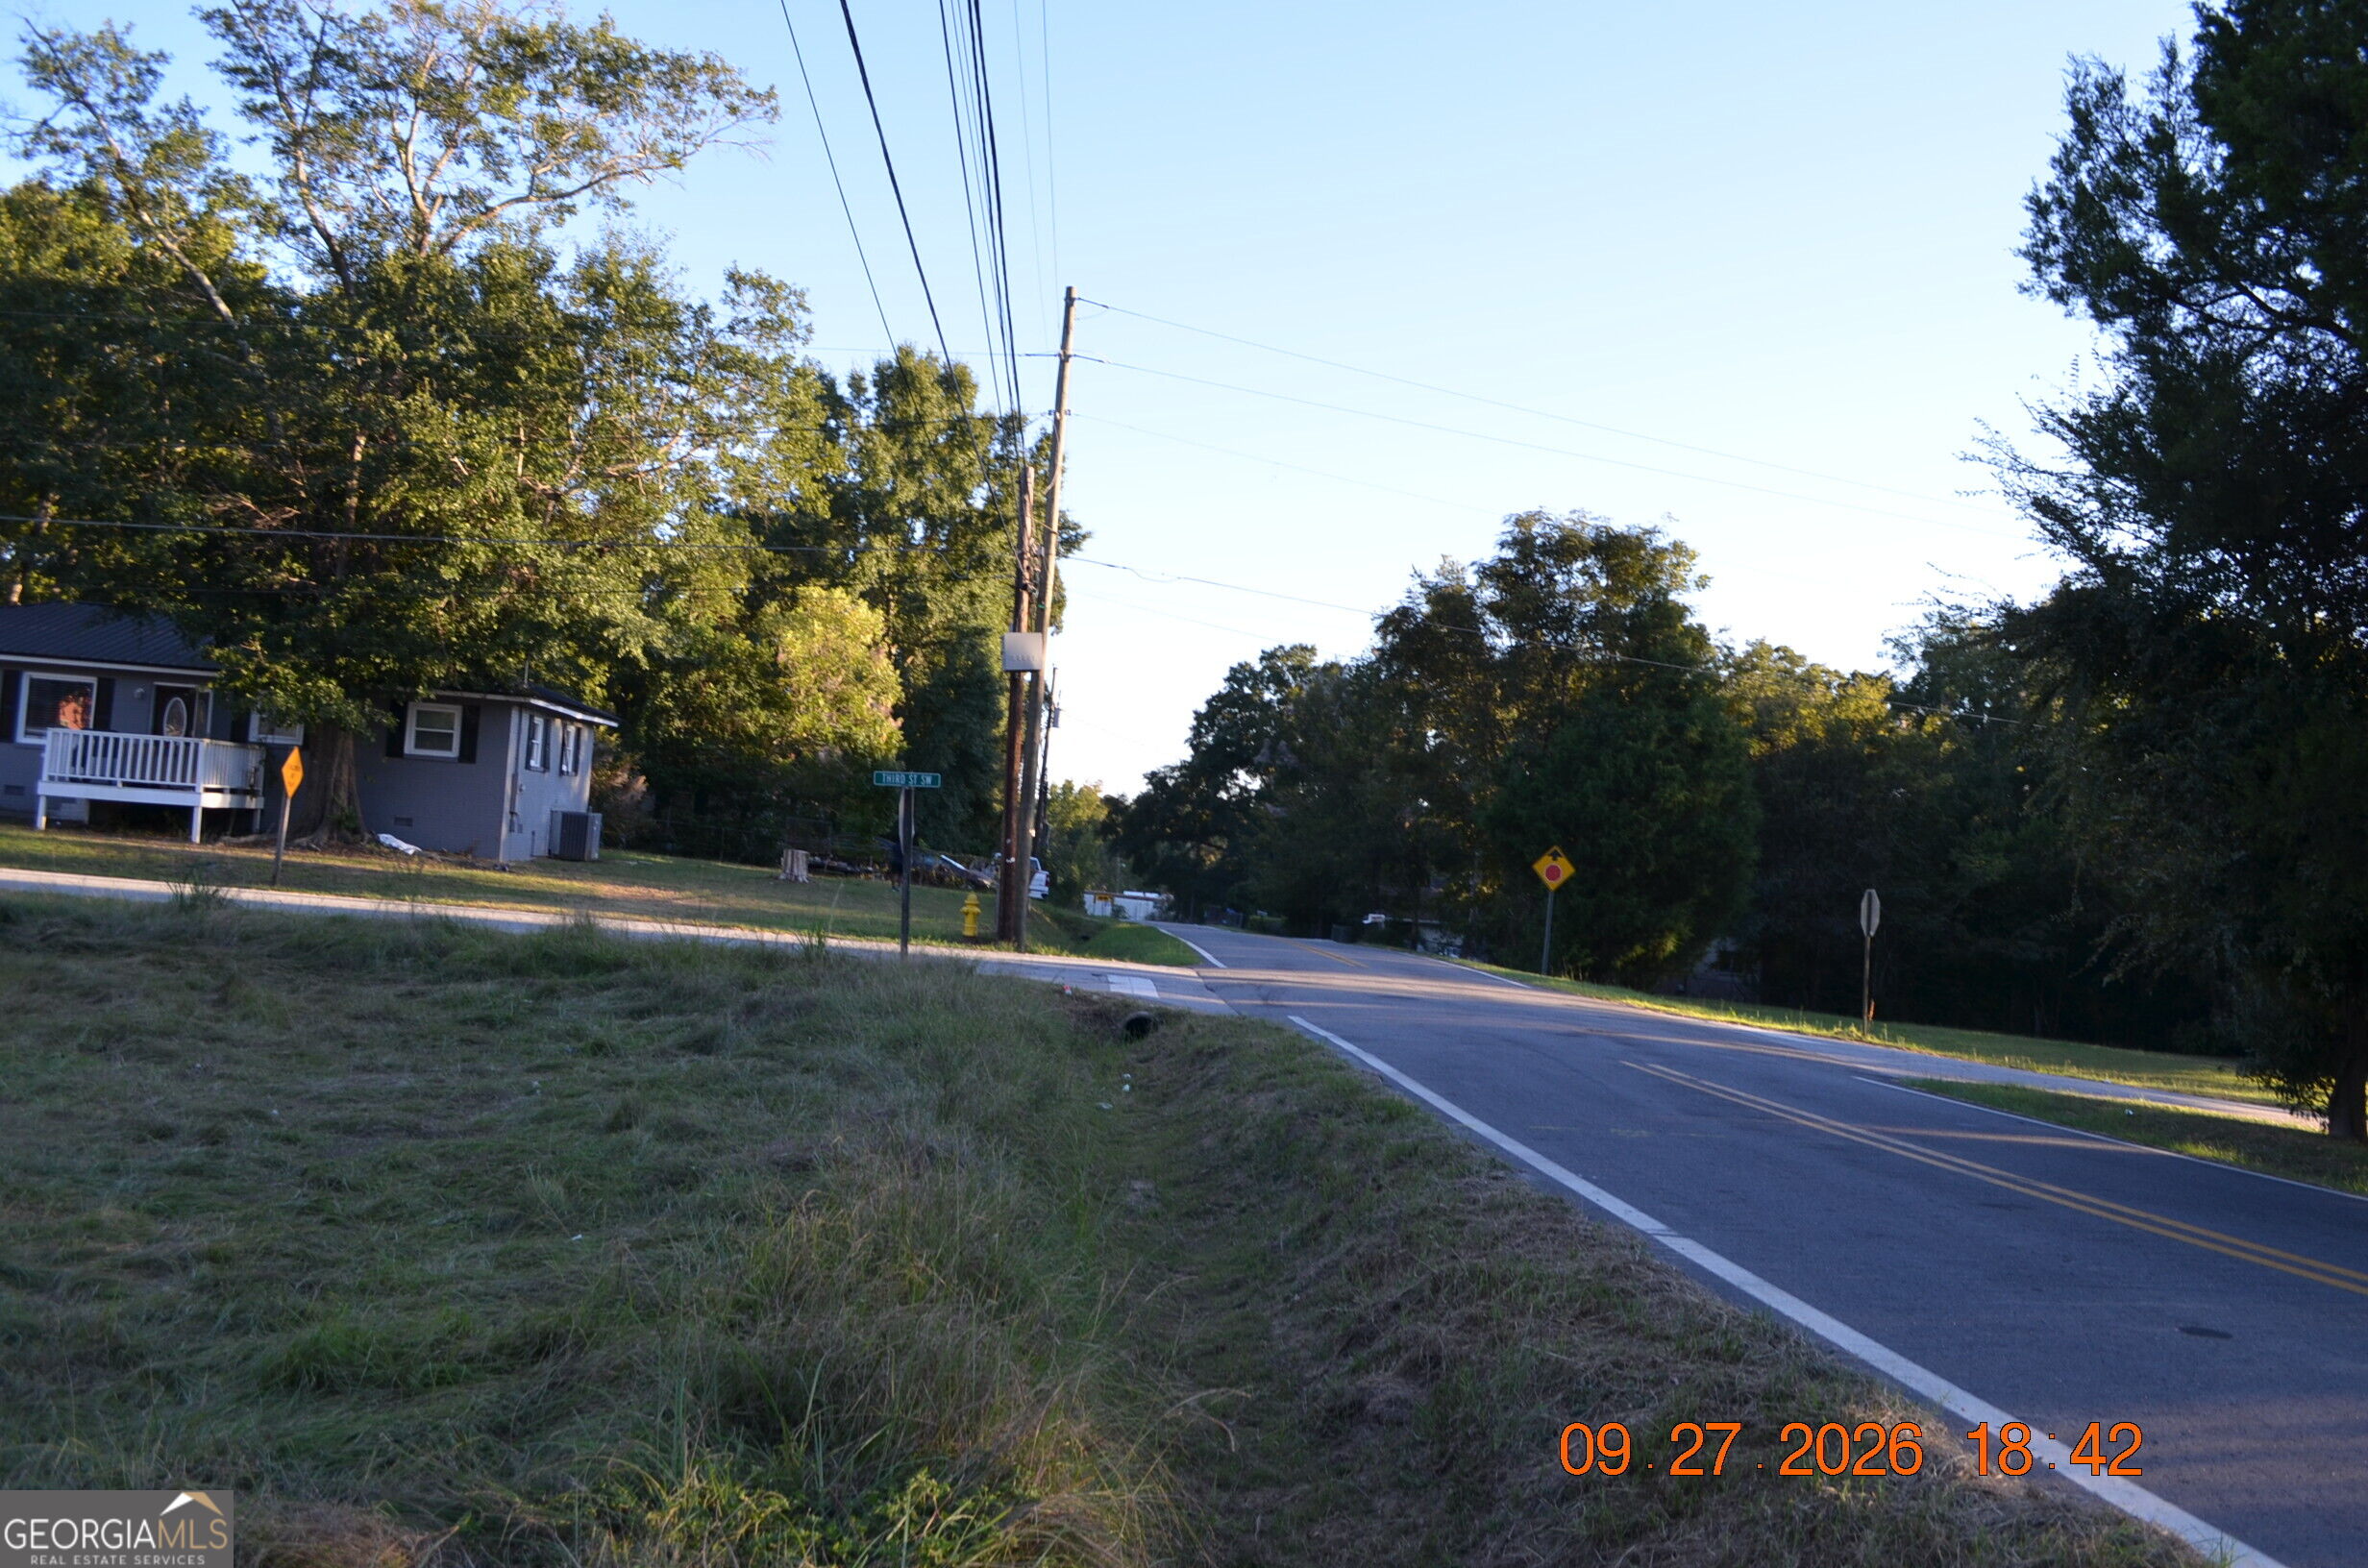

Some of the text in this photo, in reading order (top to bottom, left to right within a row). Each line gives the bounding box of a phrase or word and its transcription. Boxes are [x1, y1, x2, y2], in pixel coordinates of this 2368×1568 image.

[882, 772, 933, 786] THIRD ST SW
